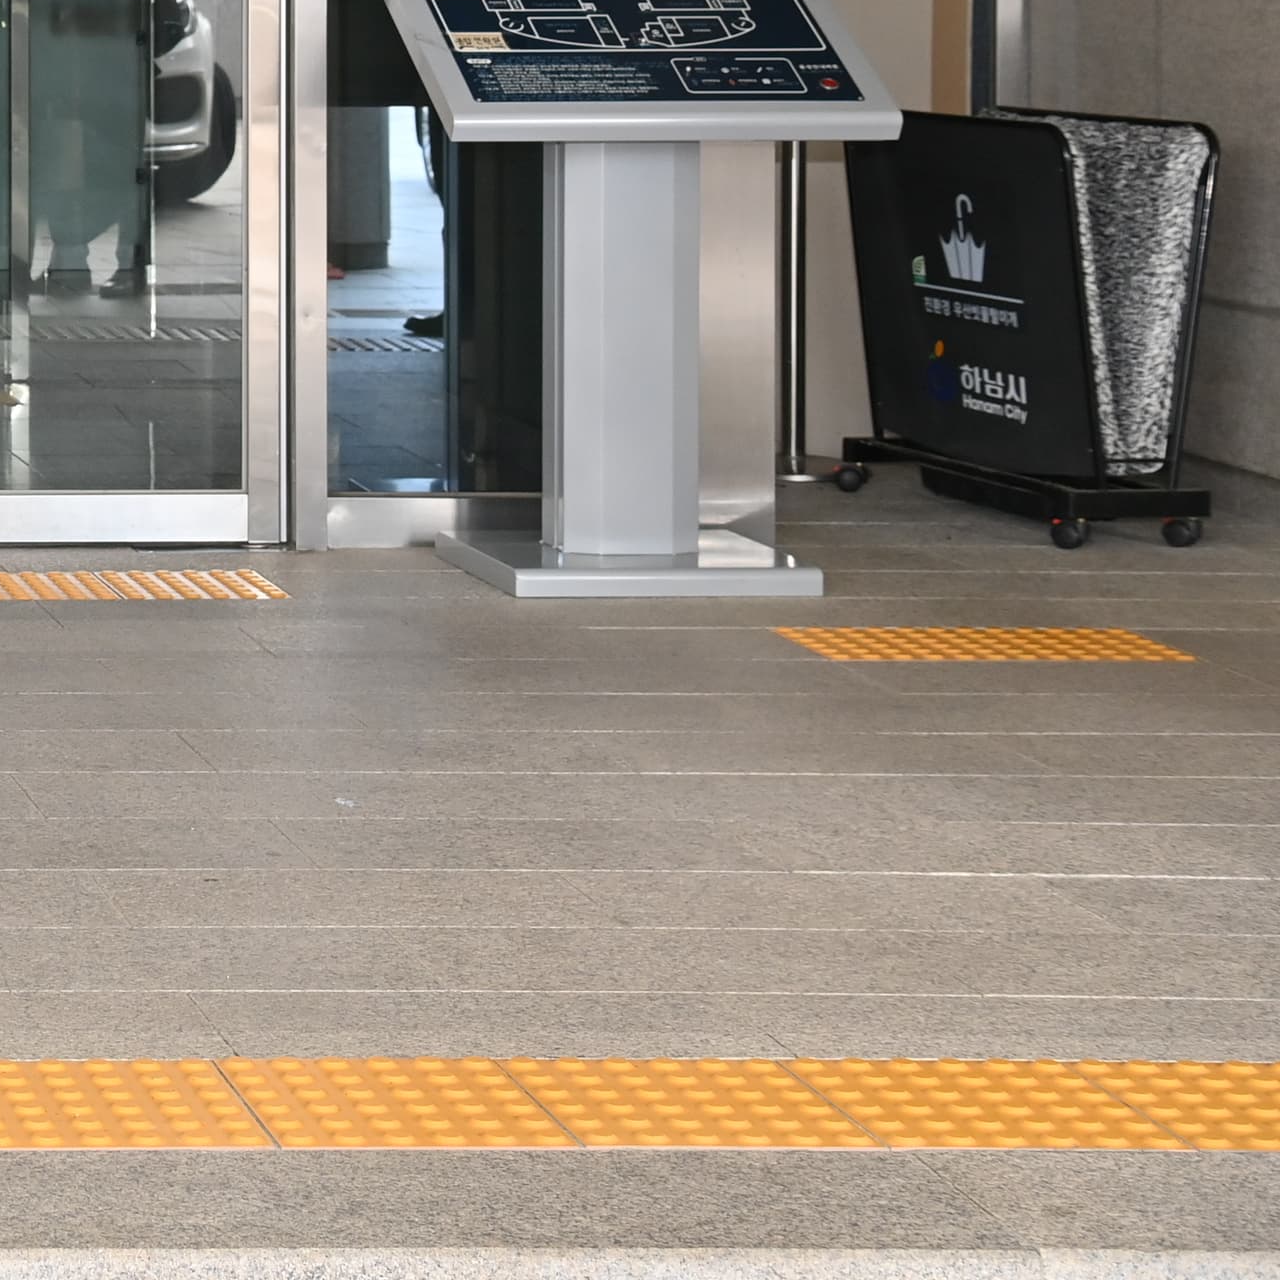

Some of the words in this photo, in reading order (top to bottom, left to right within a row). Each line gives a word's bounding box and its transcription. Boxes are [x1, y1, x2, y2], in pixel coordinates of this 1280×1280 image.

[959, 363, 1027, 405] 하남시
[962, 393, 1004, 417] Hanam
[1004, 403, 1028, 425] City
